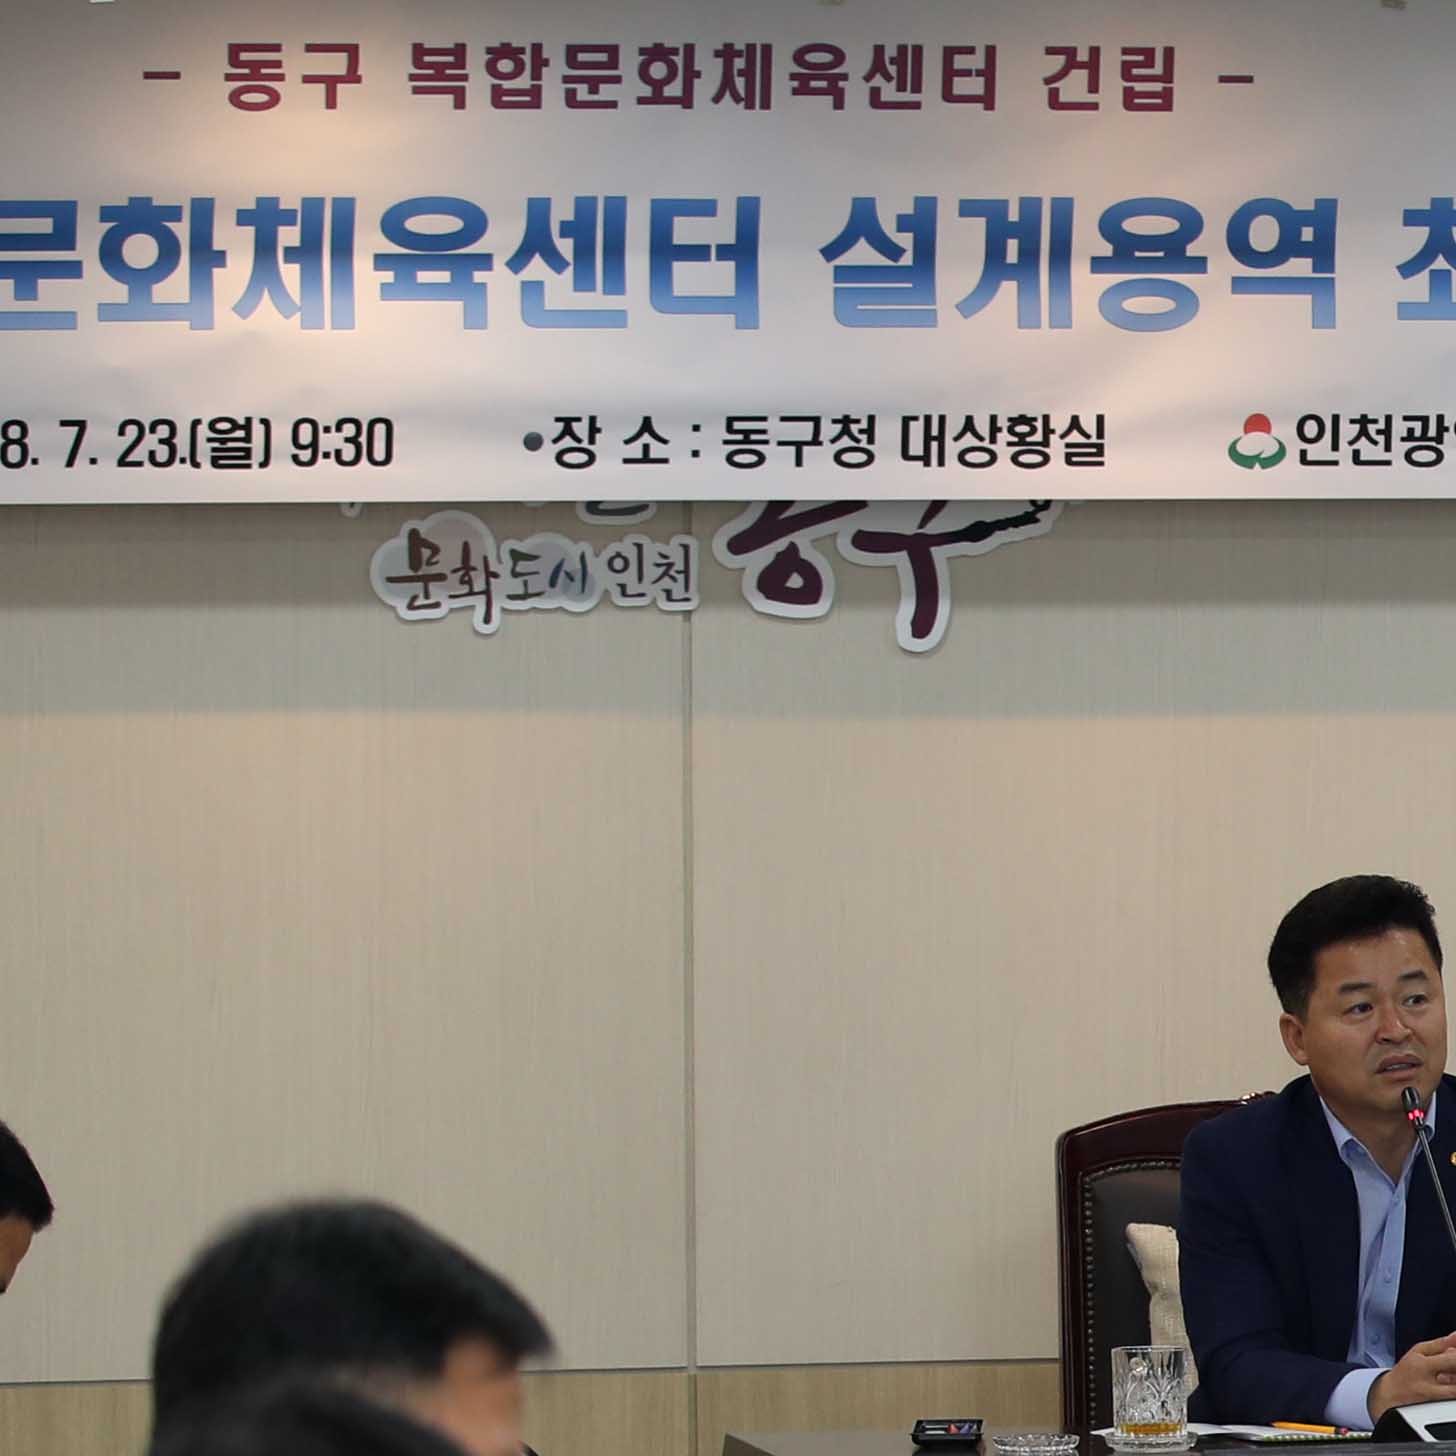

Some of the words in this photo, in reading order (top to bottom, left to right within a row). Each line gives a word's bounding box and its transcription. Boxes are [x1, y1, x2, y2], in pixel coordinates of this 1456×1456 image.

[224, 42, 362, 111] 동구
[408, 42, 997, 111] 복합문화체육센터
[1042, 45, 1175, 112] 건립
[0, 195, 761, 330] 문화체육센터
[818, 196, 1338, 333] 설계용역
[59, 419, 98, 468] 7.
[116, 416, 272, 469] 23.(월)
[291, 416, 393, 468] 9:30
[721, 414, 877, 468] 동구청
[901, 414, 1107, 468] 대상황실
[606, 542, 692, 603] 인천
